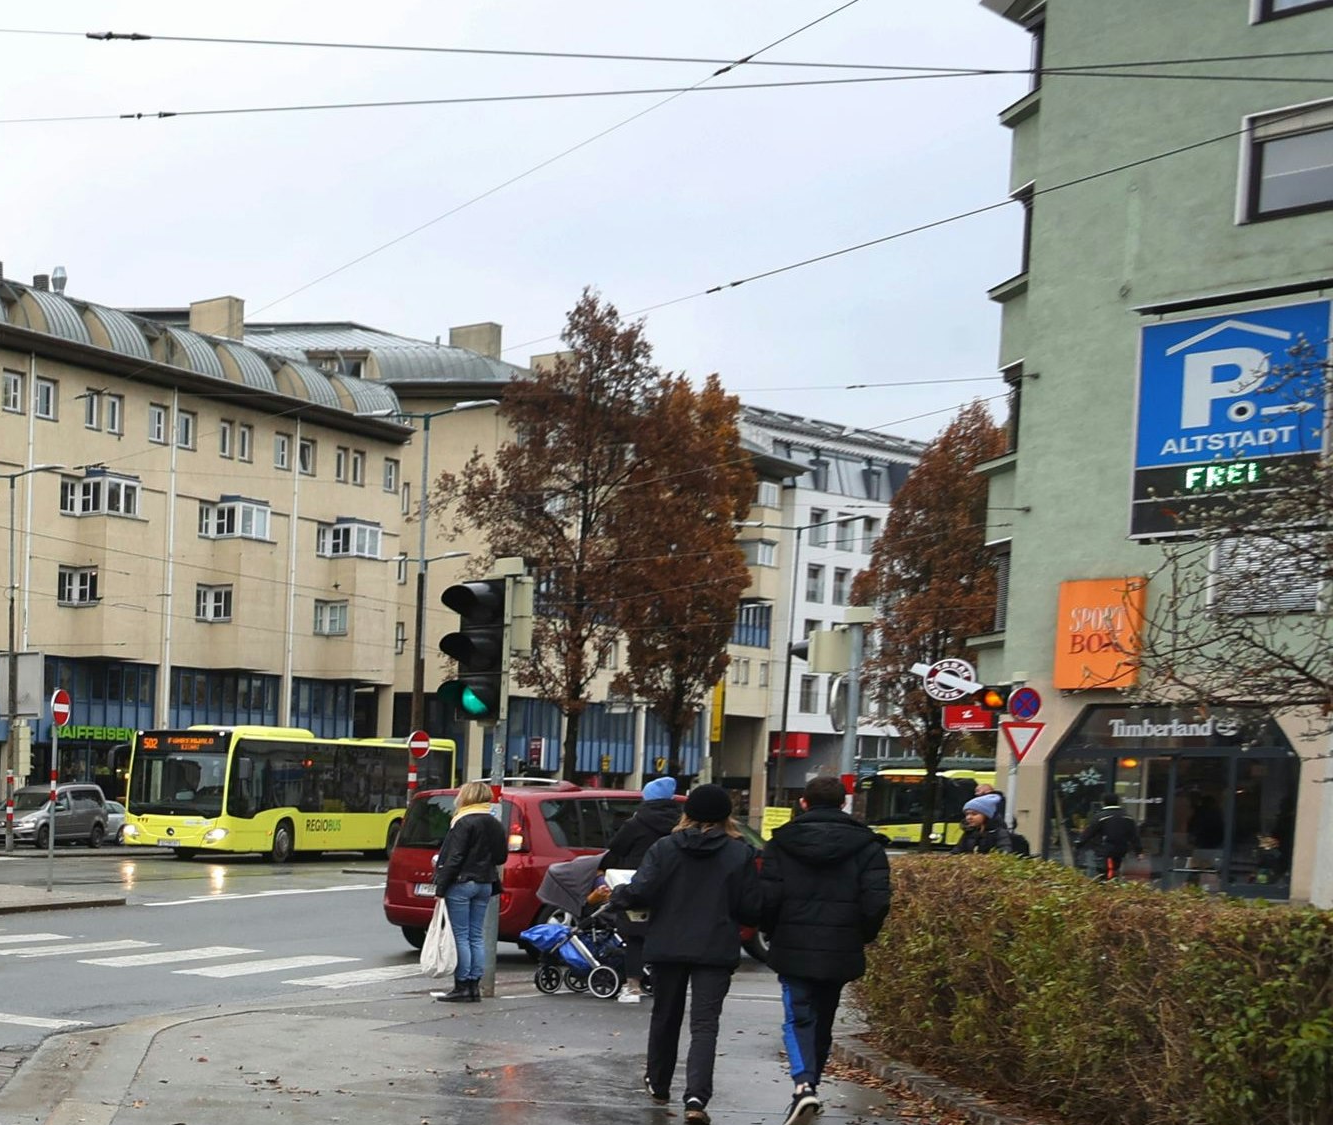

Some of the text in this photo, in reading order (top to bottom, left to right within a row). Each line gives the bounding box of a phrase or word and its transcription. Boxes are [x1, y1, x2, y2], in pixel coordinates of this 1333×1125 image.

[1181, 346, 1270, 430] P
[1159, 425, 1297, 455] ALTSTADT
[1185, 462, 1258, 489] FREI
[1069, 605, 1125, 632] SPORT
[1068, 633, 1121, 655] BOX
[935, 661, 973, 680] TABAK
[1108, 718, 1213, 737] Timberland
[142, 736, 159, 750] 502
[305, 819, 342, 832] REGIOBUS
